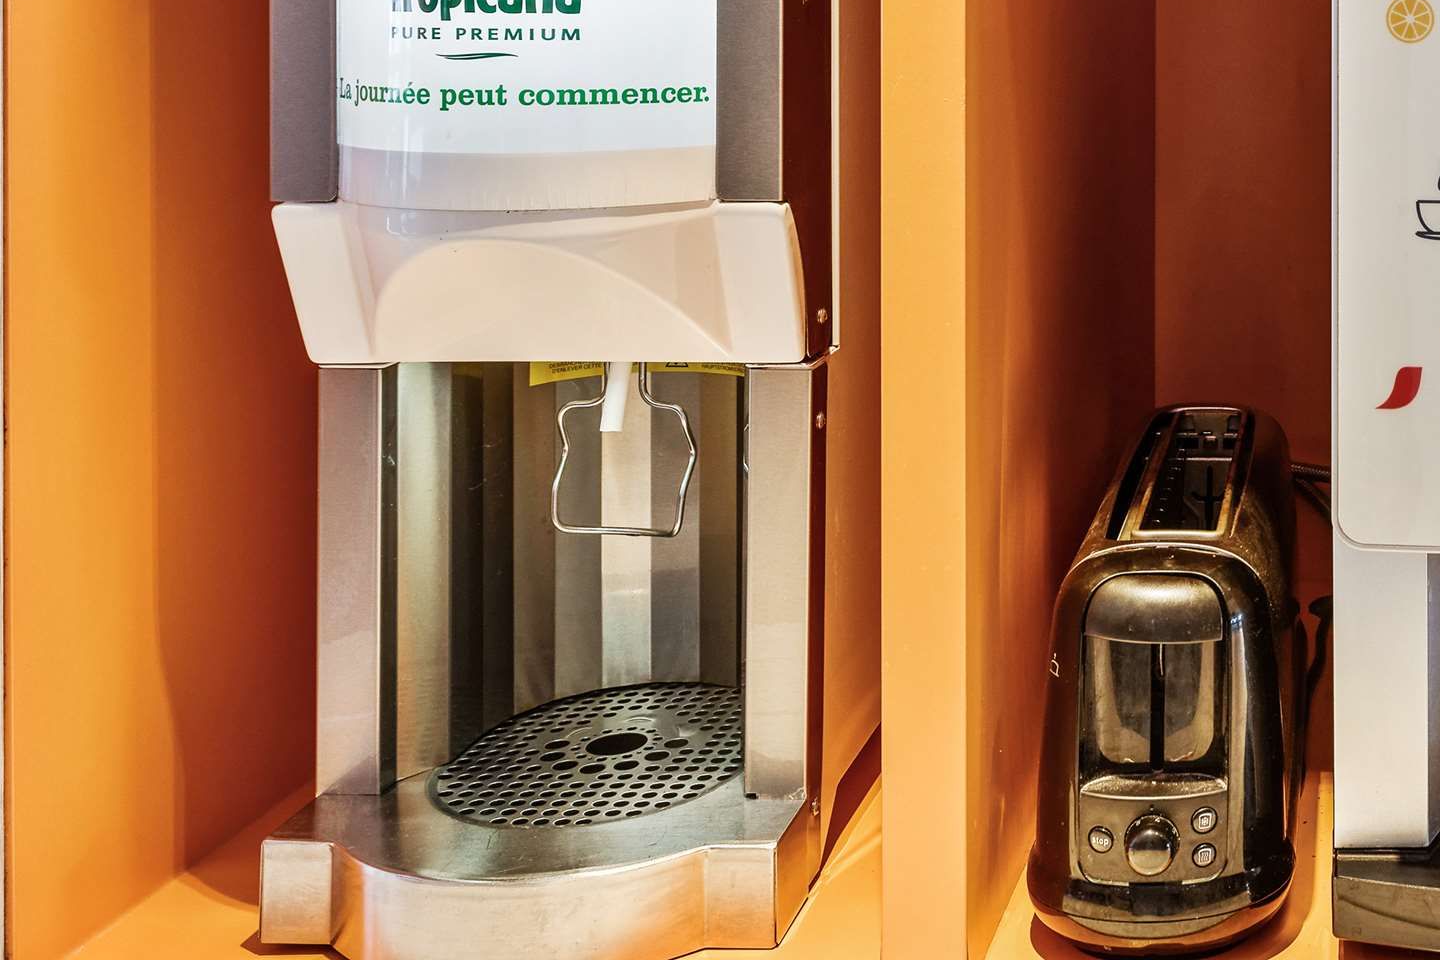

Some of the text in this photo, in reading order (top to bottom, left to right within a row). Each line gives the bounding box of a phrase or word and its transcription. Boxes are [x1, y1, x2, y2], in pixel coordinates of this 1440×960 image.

[391, 27, 582, 41] PURE PREMIUM
[339, 77, 710, 111] La journée peut commencer.
[1092, 836, 1109, 847] stop
